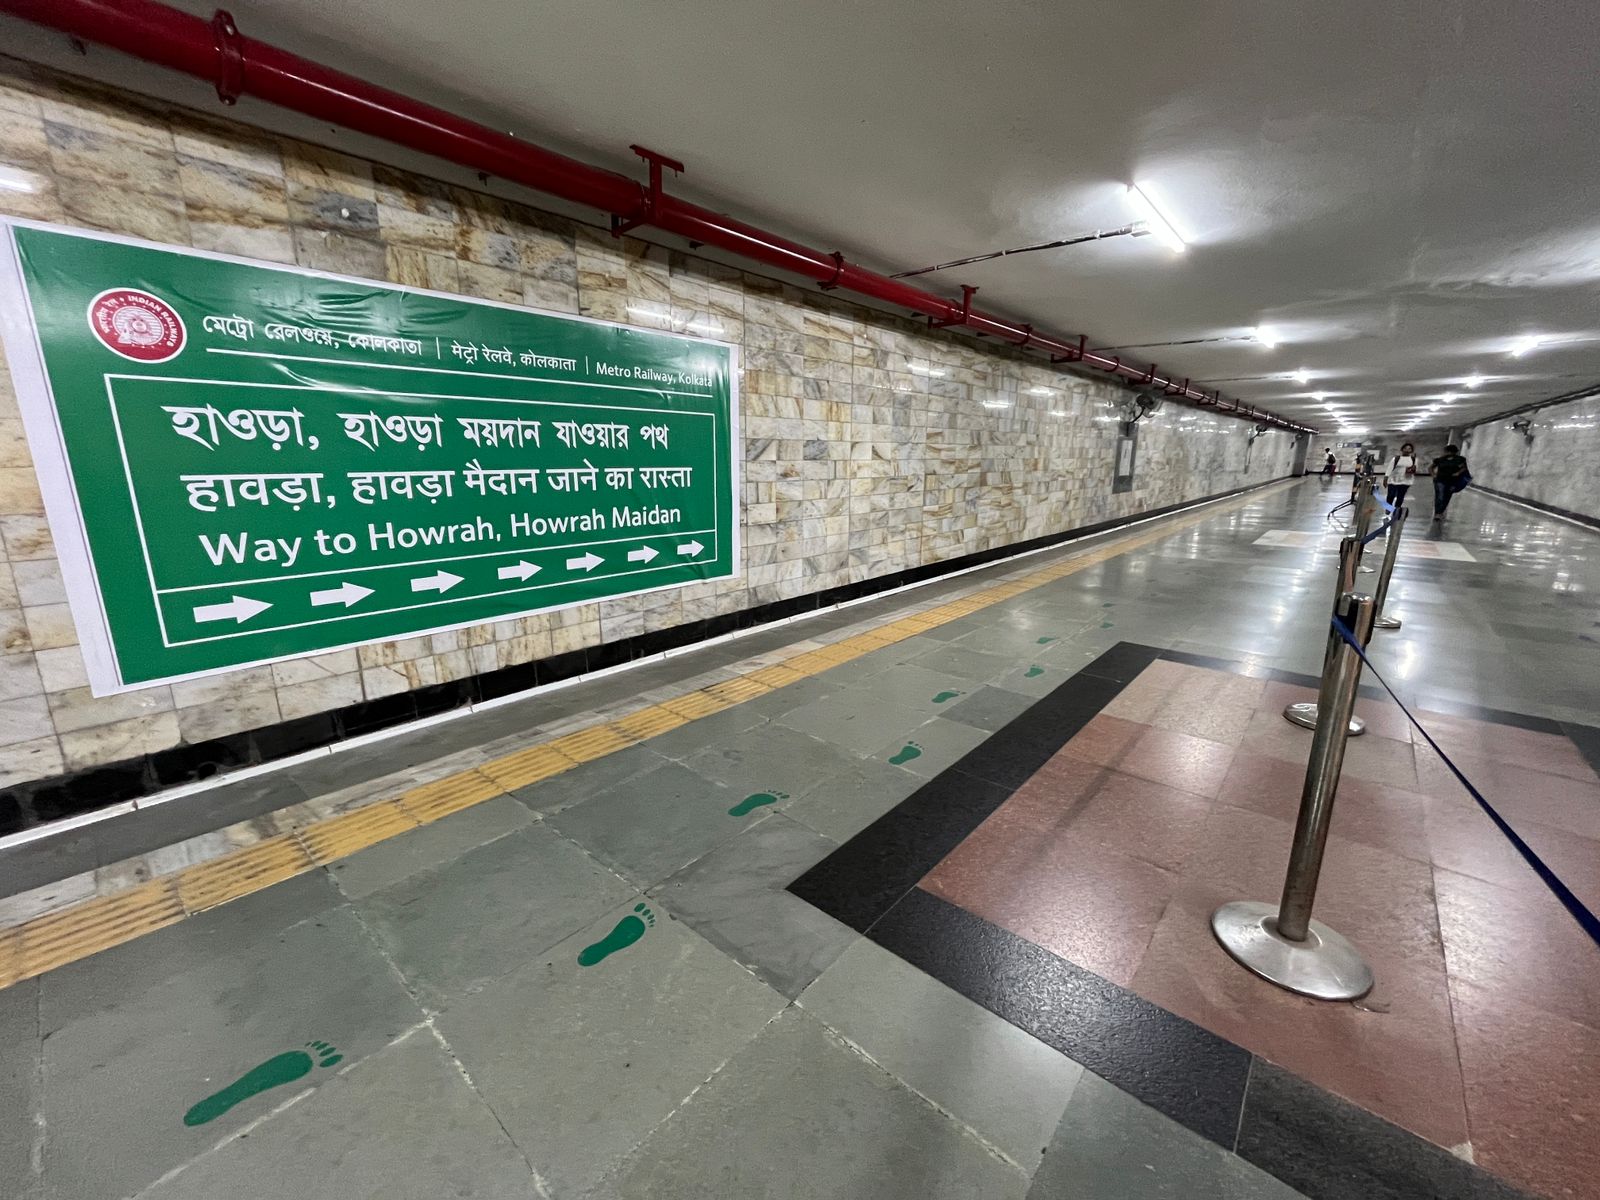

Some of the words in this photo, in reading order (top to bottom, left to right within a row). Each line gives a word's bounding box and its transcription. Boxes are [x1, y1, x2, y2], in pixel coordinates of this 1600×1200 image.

[127, 295, 162, 312] INDIAN
[160, 311, 178, 347] RAILWAYS
[202, 313, 254, 341] মেট্রো
[264, 322, 340, 350] রেলওয়ে,
[348, 332, 423, 356] কোলকাতা
[451, 340, 478, 366] मेट्रो
[482, 341, 517, 367] रेलवे,
[519, 349, 577, 372] कोलकाता
[596, 361, 631, 378] Metro
[634, 366, 676, 385] Railway,
[678, 372, 713, 388] Kolkata
[160, 403, 320, 451] হাওড়া,
[336, 410, 444, 452] হাওড়া
[456, 417, 541, 449] ময়দান
[552, 419, 630, 450] যাওয়ার
[639, 422, 670, 451] পথ
[179, 472, 336, 512] हावड़ा,
[347, 470, 456, 505] हावड़ा
[462, 458, 540, 496] मैदान
[546, 458, 599, 492] जाने
[604, 467, 634, 490] का
[639, 467, 693, 489] रास्ता
[198, 532, 302, 568] Way
[313, 529, 357, 556] to
[367, 515, 501, 552] Howrah,
[510, 508, 606, 538] Howrah
[612, 504, 681, 529] Maidan
